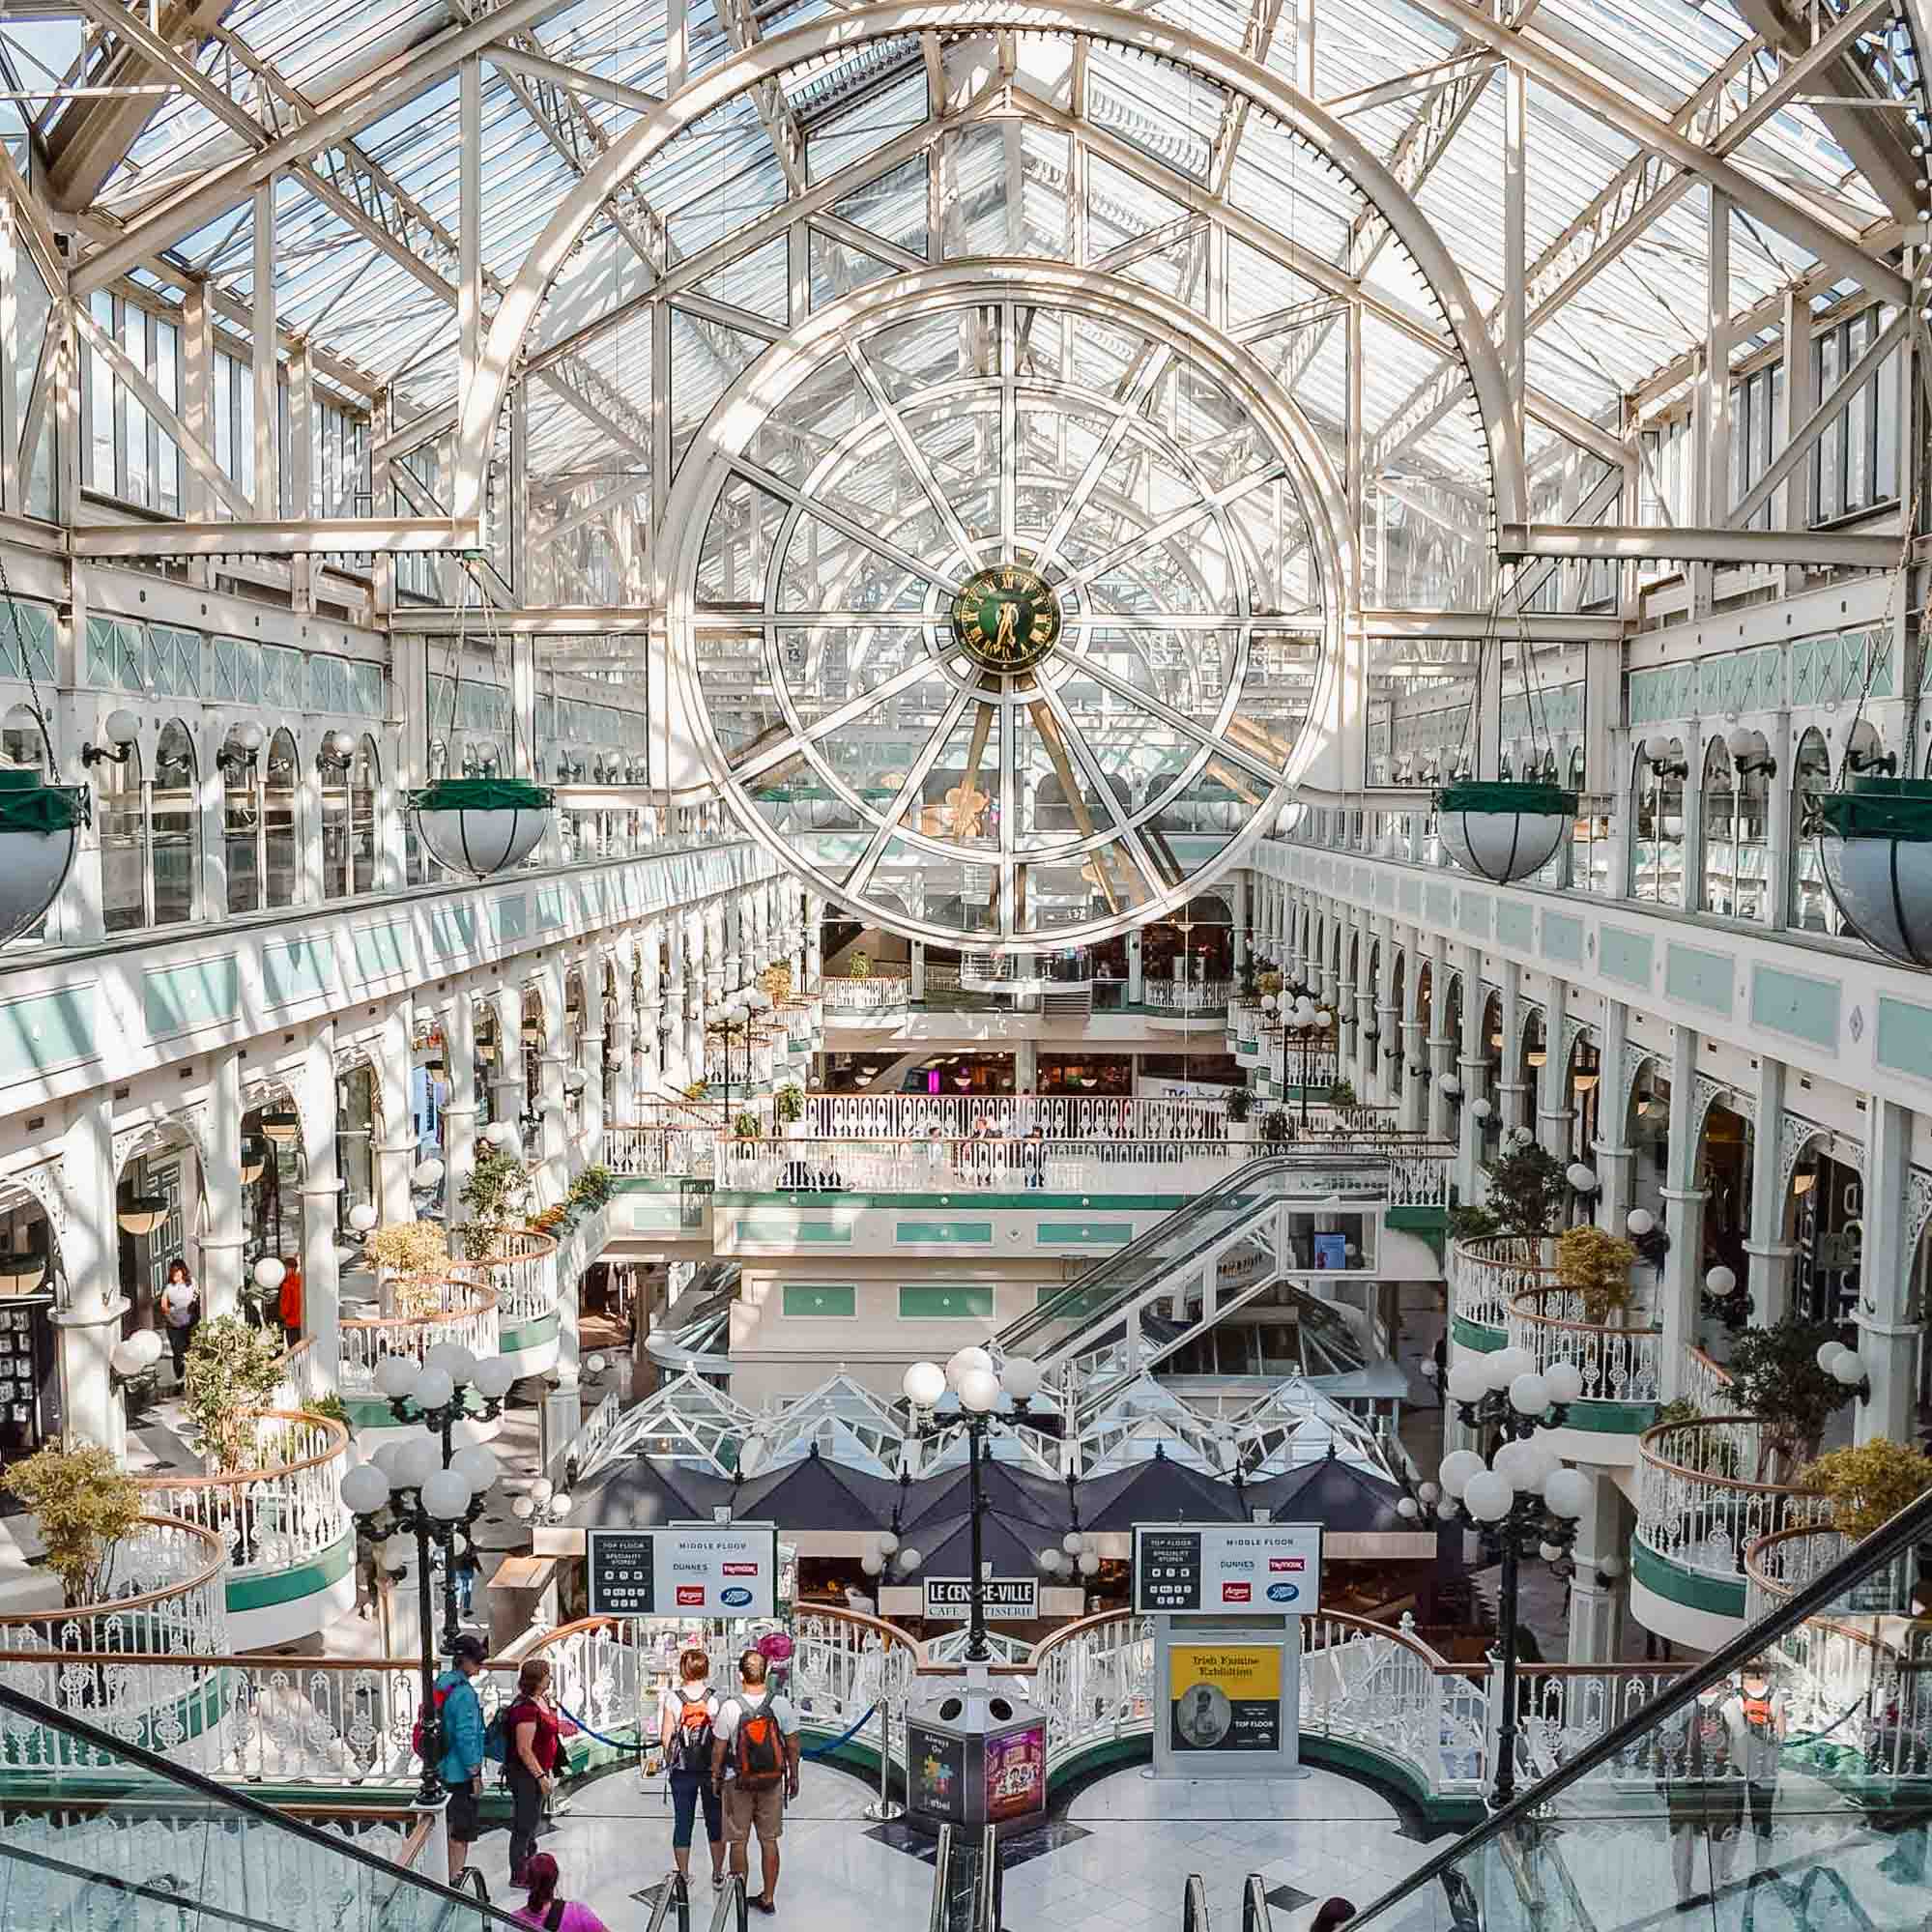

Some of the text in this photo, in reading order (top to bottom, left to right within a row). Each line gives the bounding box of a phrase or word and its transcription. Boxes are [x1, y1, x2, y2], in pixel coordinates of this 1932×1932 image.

[931, 1584, 944, 1600] LE
[1193, 1656, 1259, 1665] Irish Famine
